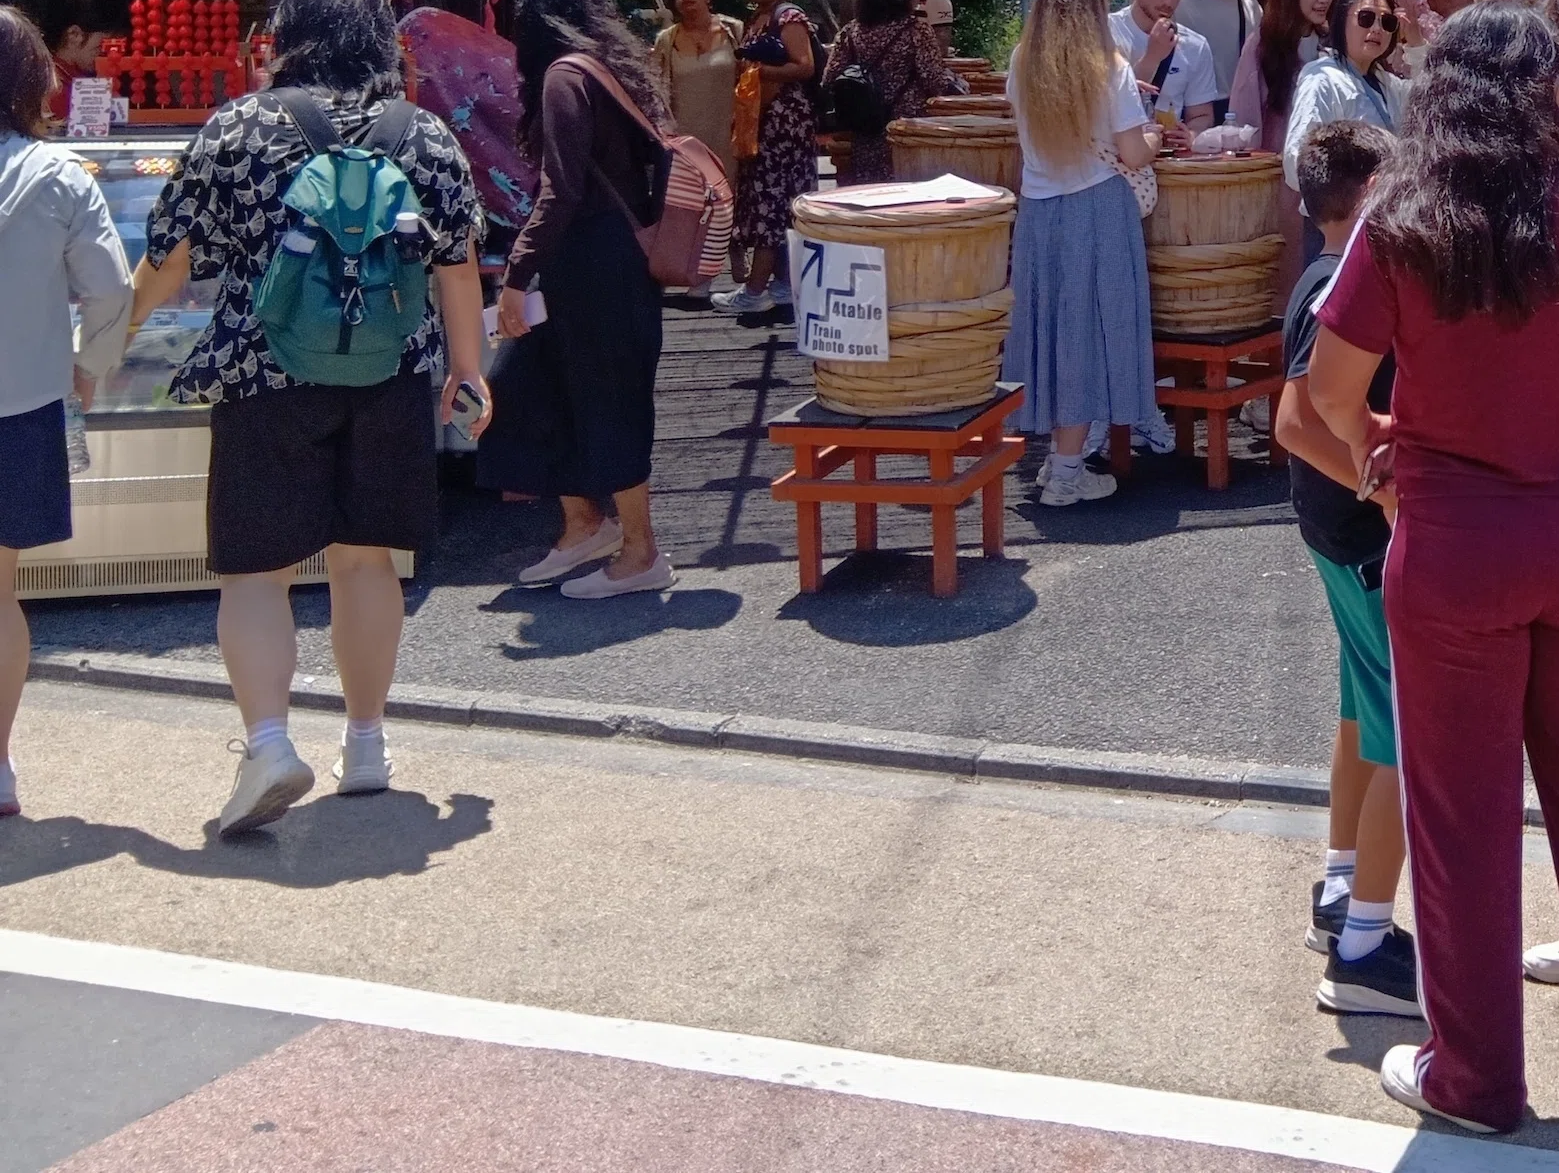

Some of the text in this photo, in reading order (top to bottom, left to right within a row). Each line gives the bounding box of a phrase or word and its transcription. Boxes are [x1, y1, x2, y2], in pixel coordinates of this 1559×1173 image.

[831, 300, 883, 321] 4table
[813, 323, 842, 340] Train
[812, 339, 879, 357] photo spot
